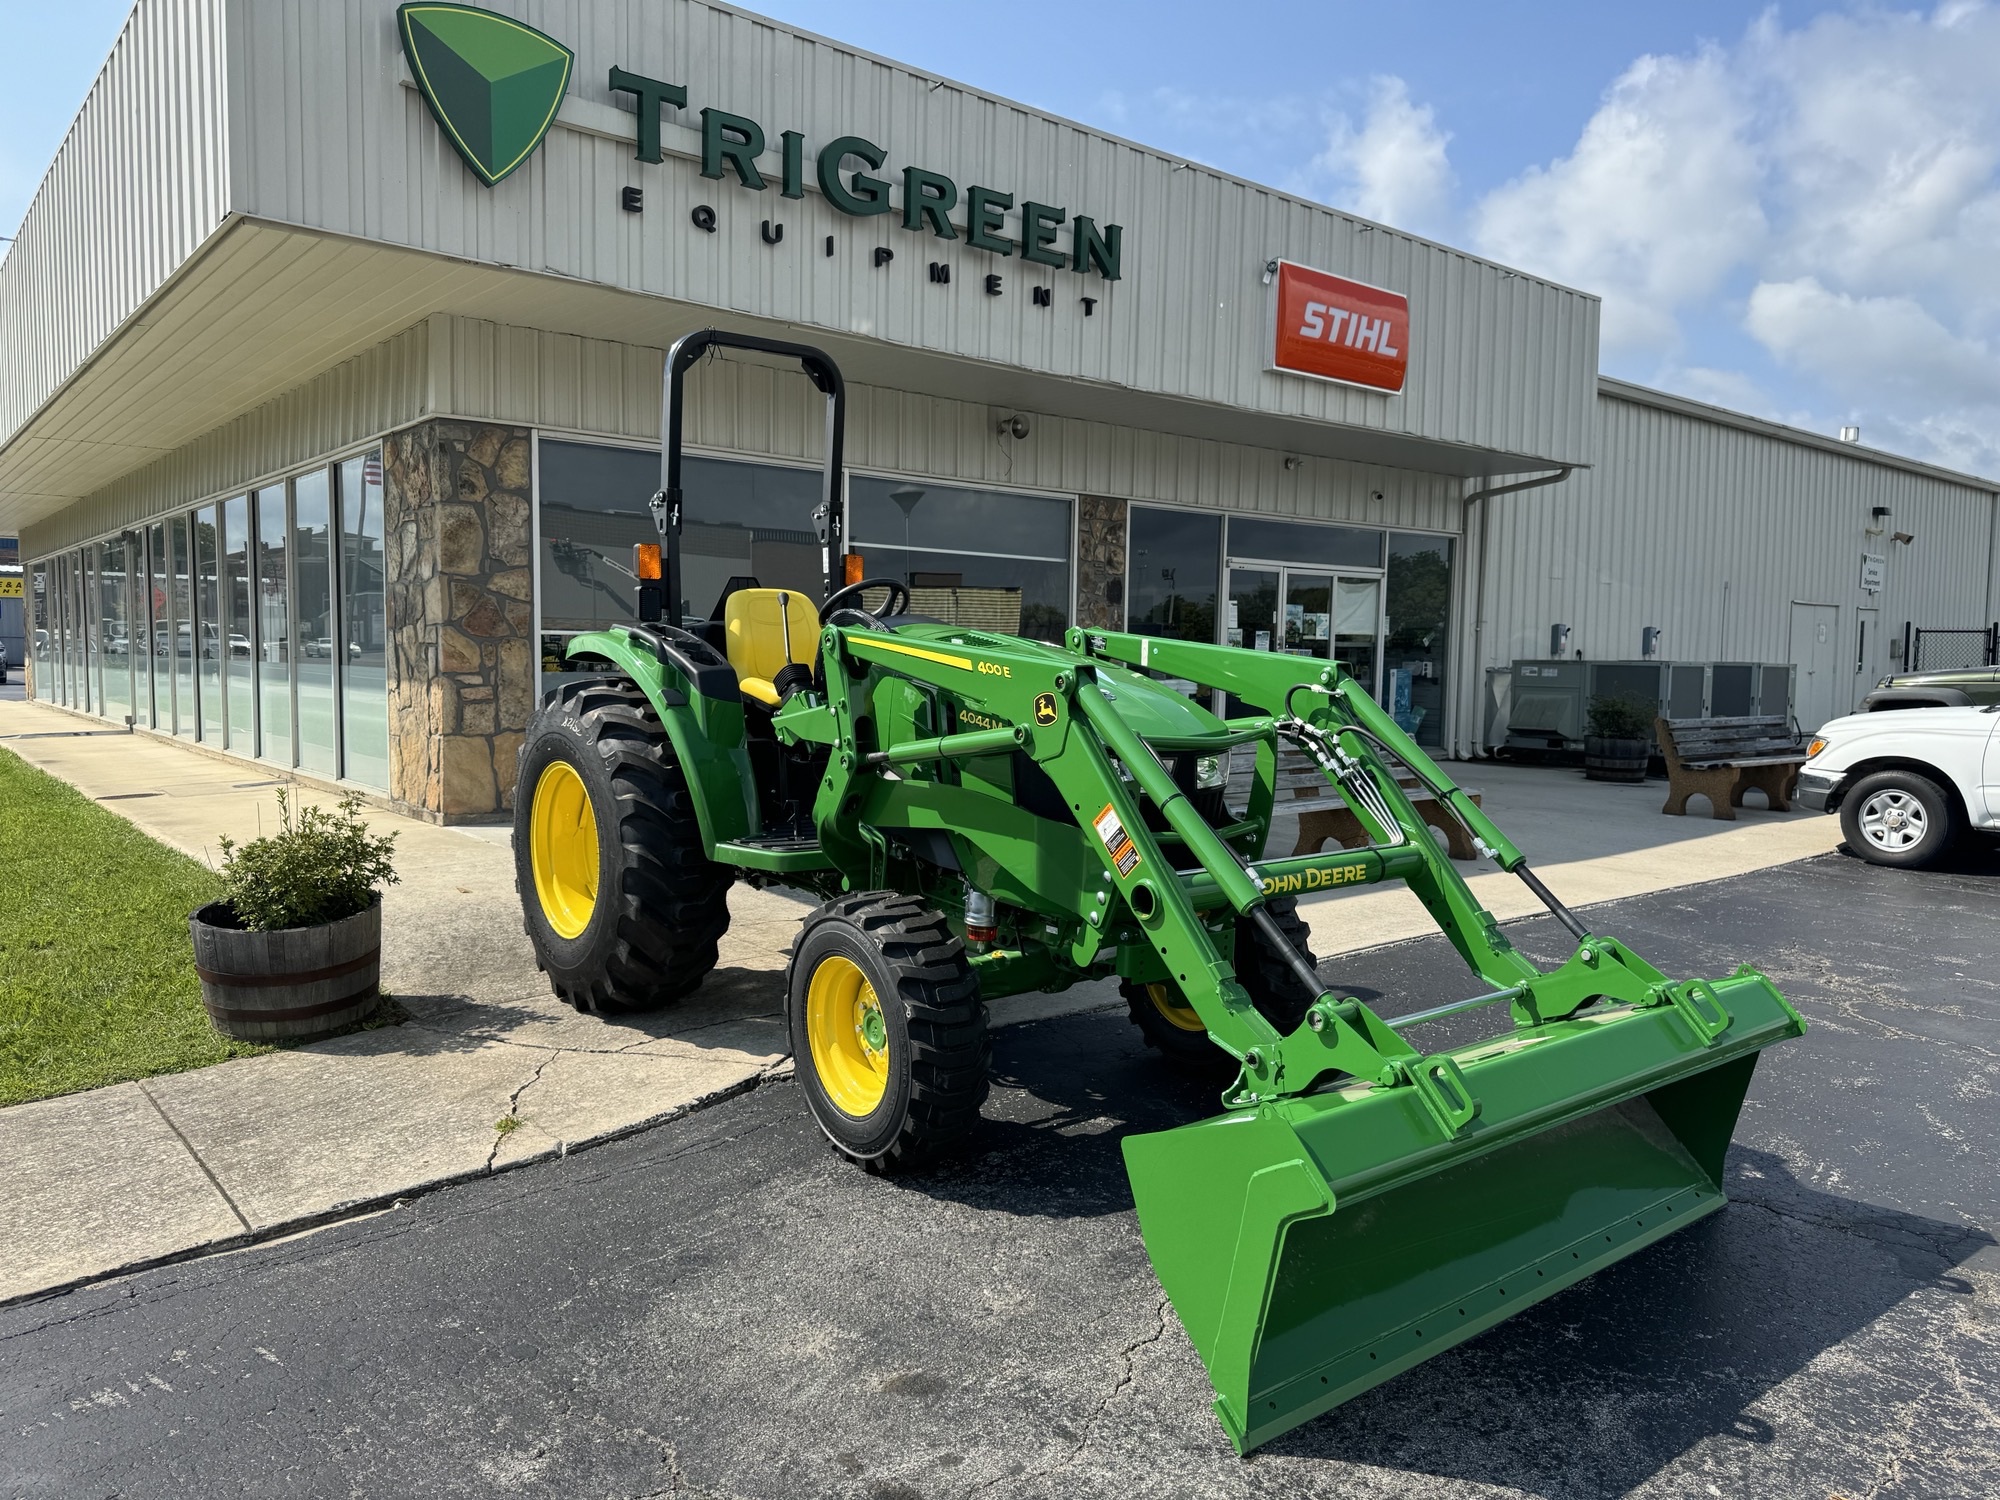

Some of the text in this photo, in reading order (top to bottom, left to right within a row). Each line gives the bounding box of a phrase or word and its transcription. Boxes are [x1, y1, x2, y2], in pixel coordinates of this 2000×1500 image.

[608, 65, 1122, 281] TRIGREEN
[622, 186, 1097, 316] EQUIPMENT
[1299, 301, 1399, 357] STIHL
[1261, 864, 1366, 895] OHN DEERE
